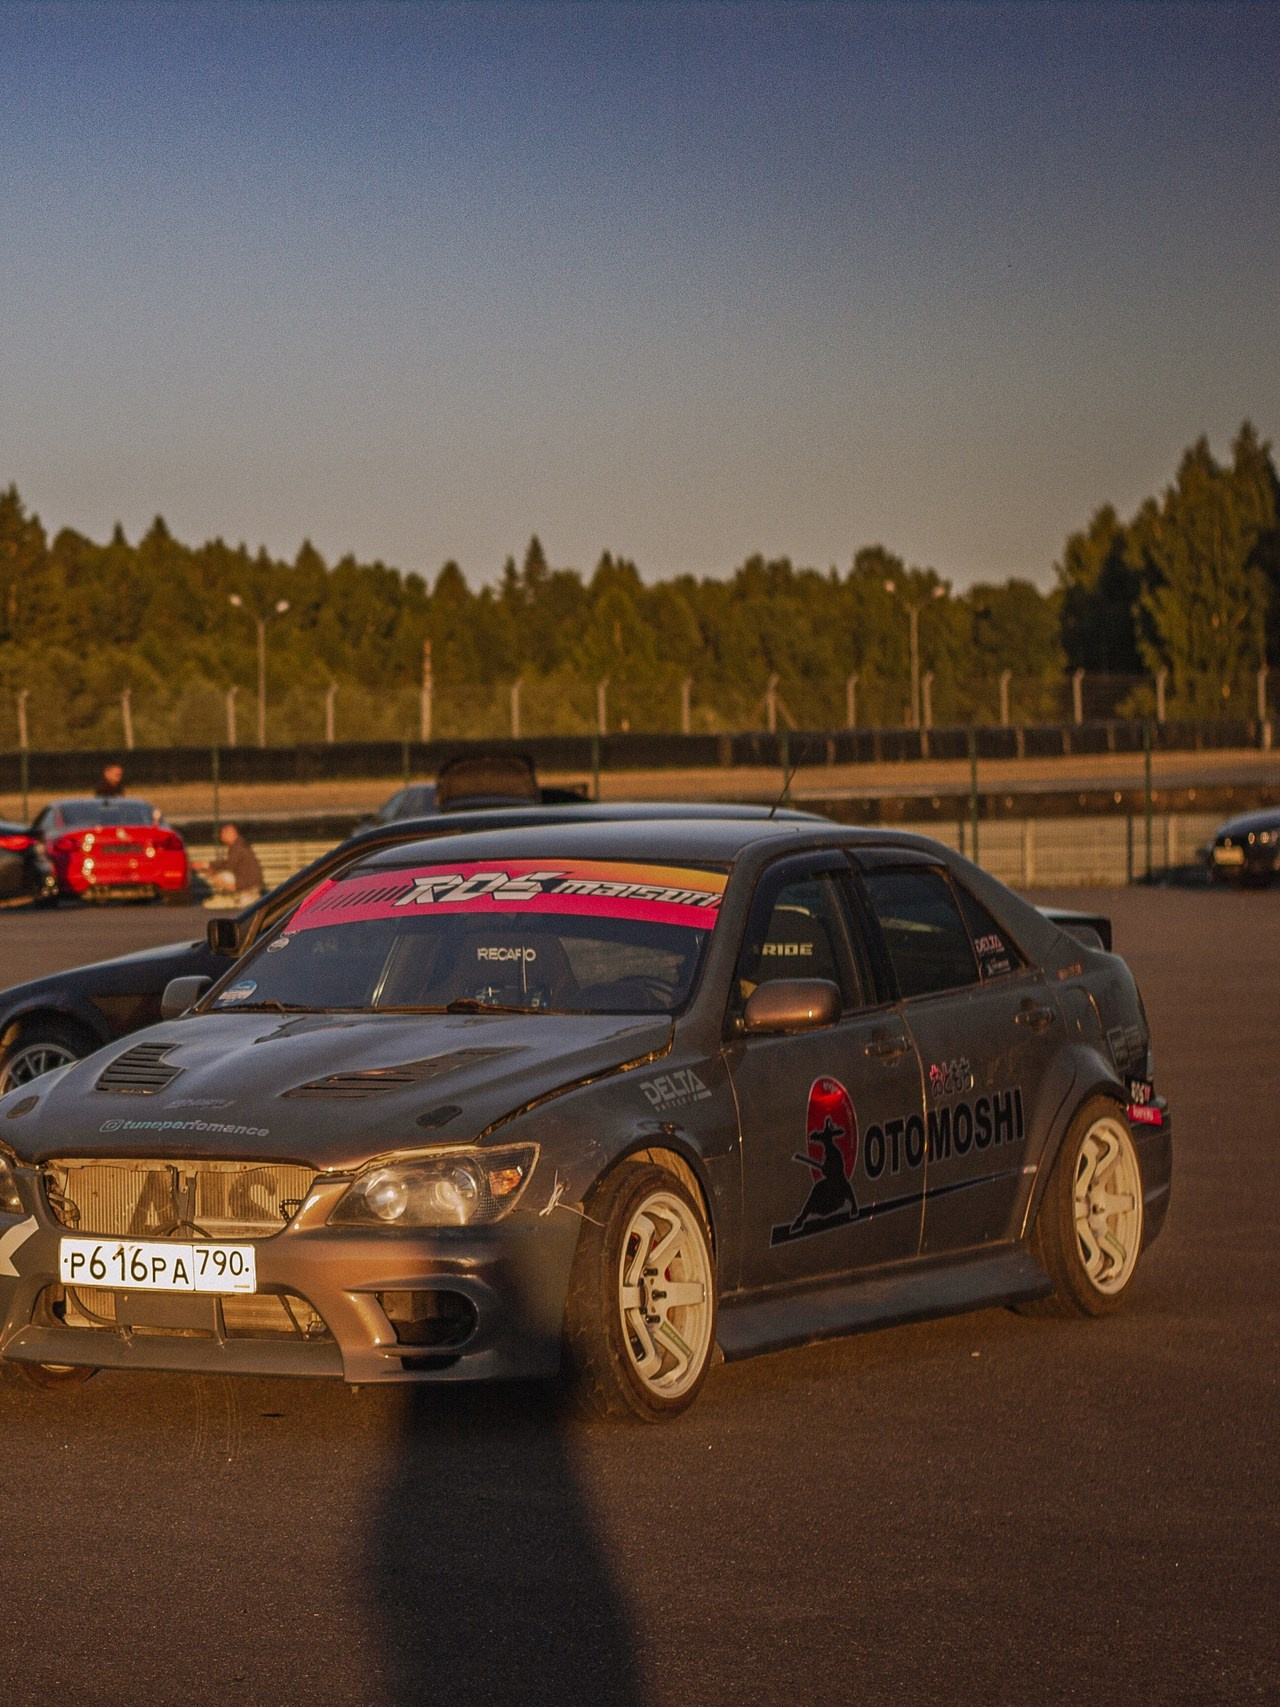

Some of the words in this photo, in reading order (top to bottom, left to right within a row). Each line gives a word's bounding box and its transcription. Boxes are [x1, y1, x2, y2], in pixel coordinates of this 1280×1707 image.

[391, 871, 570, 906] RDS
[477, 947, 536, 961] RECARO
[760, 942, 814, 956] RIDE
[639, 1069, 707, 1105] DELTA
[863, 1088, 1025, 1181] OTOMOSHI
[195, 1249, 244, 1276] 790
